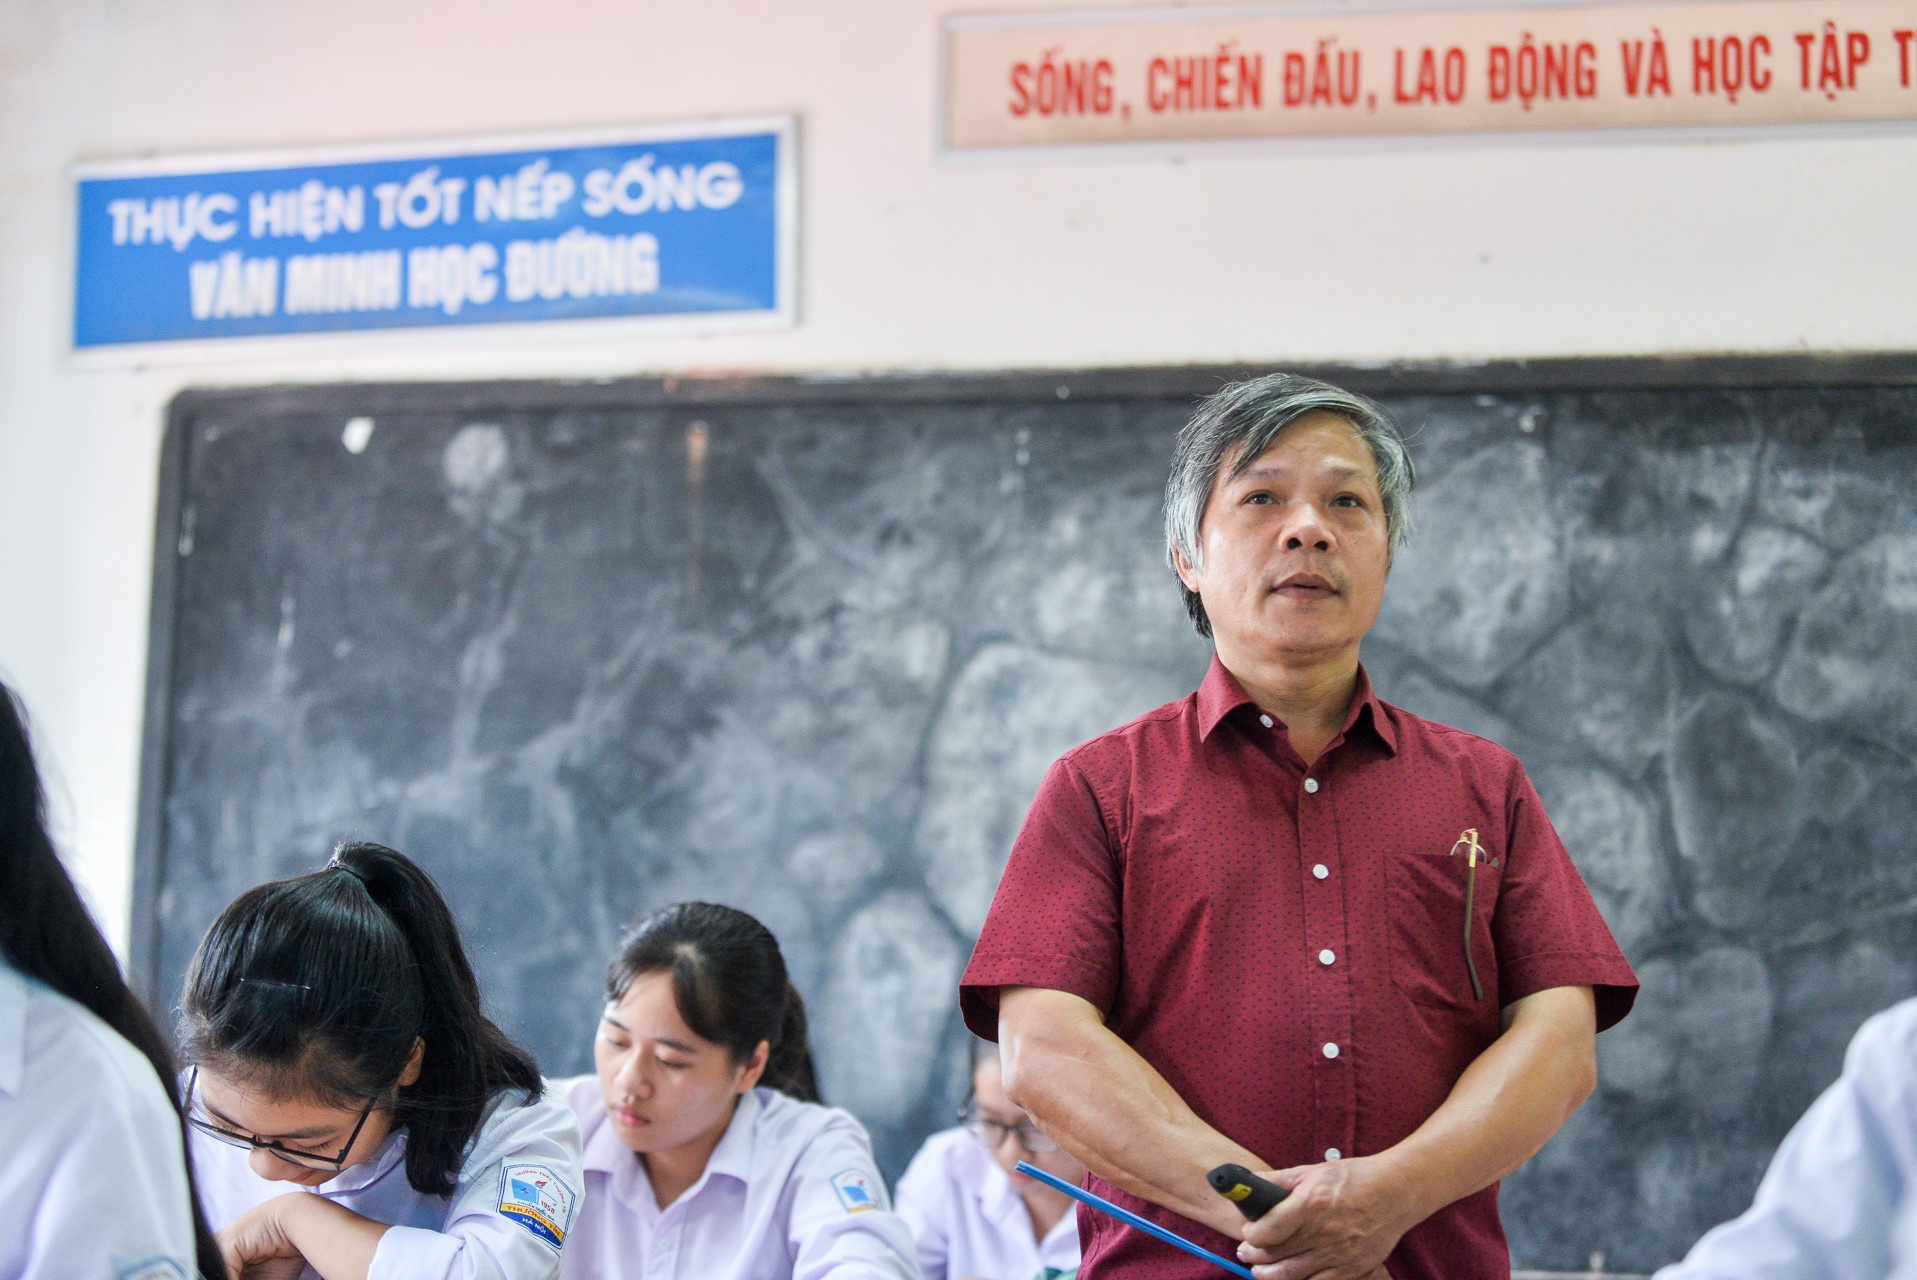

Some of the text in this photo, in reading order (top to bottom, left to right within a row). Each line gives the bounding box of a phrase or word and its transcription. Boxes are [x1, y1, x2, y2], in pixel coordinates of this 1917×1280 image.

[1147, 39, 1264, 113] CHIẾN
[1393, 45, 1468, 105] LAO
[1486, 31, 1598, 112] ĐỘNG
[1620, 27, 1673, 97] VÀ
[1692, 34, 1773, 104] HỌC
[1795, 20, 1872, 101] TẬP
[1893, 28, 1917, 89] T
[108, 152, 745, 252] THỰC HIỆN TỐT NẾP SỐNG
[189, 250, 279, 321] VĂN
[283, 248, 402, 315] MINH
[406, 241, 500, 316] HỌC
